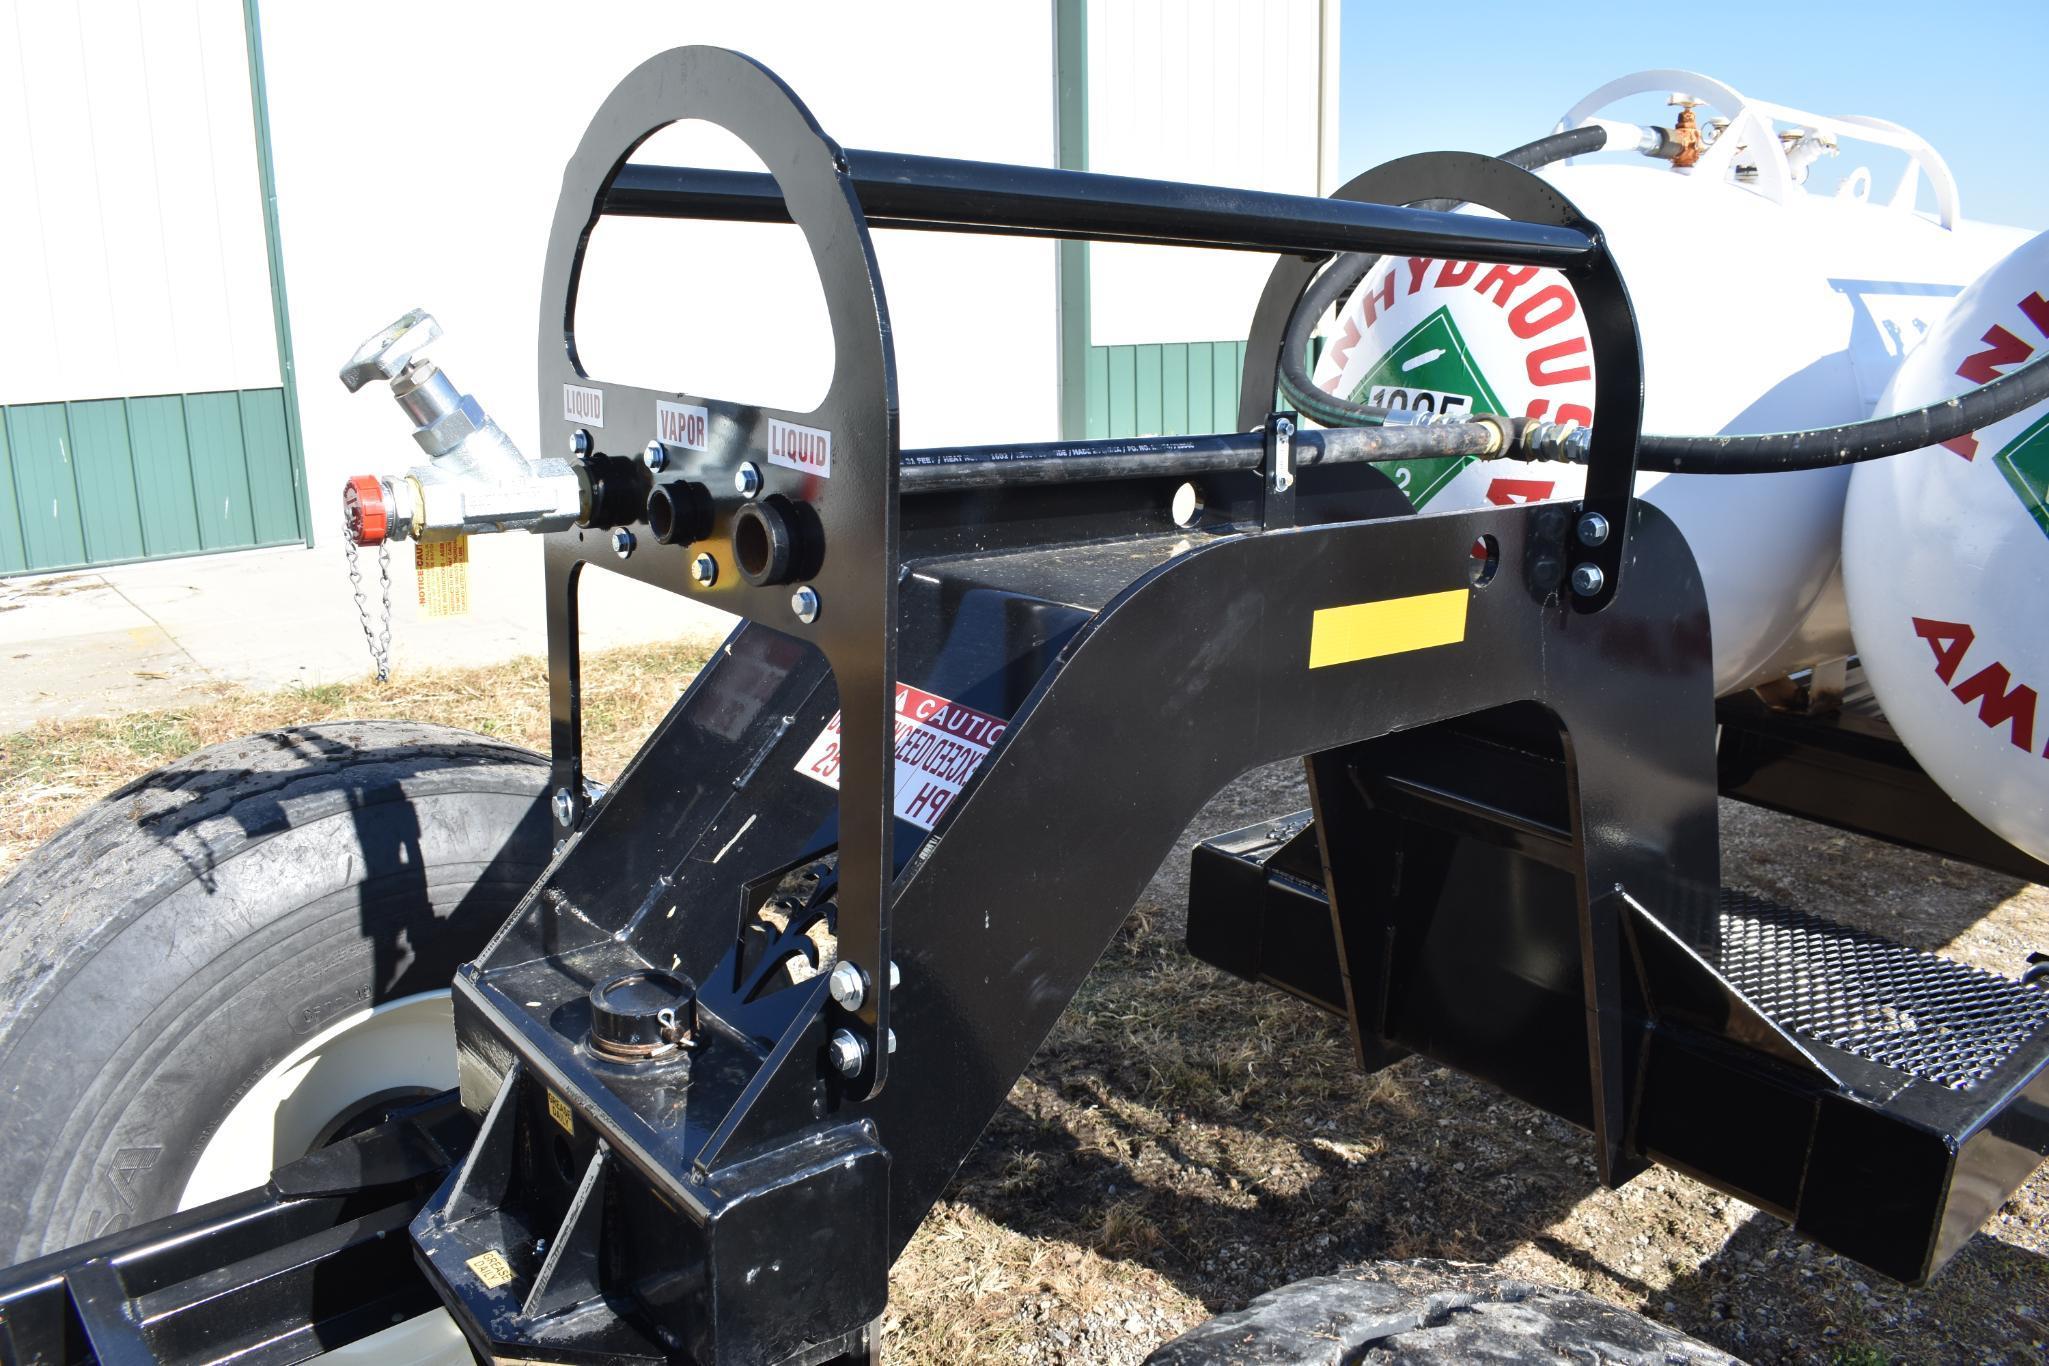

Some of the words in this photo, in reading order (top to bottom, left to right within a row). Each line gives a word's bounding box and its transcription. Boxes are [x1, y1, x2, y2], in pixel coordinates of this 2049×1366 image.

[566, 389, 601, 420] LIQUID
[660, 409, 705, 447] VAPOR
[771, 425, 827, 467] LIQUID
[1395, 467, 1412, 498] 2
[1911, 616, 2049, 759] AM
[916, 699, 1006, 745] CAUTIO
[895, 720, 936, 766] XCEED
[474, 1260, 499, 1281] DAILY
[483, 1253, 510, 1281] GREASE
